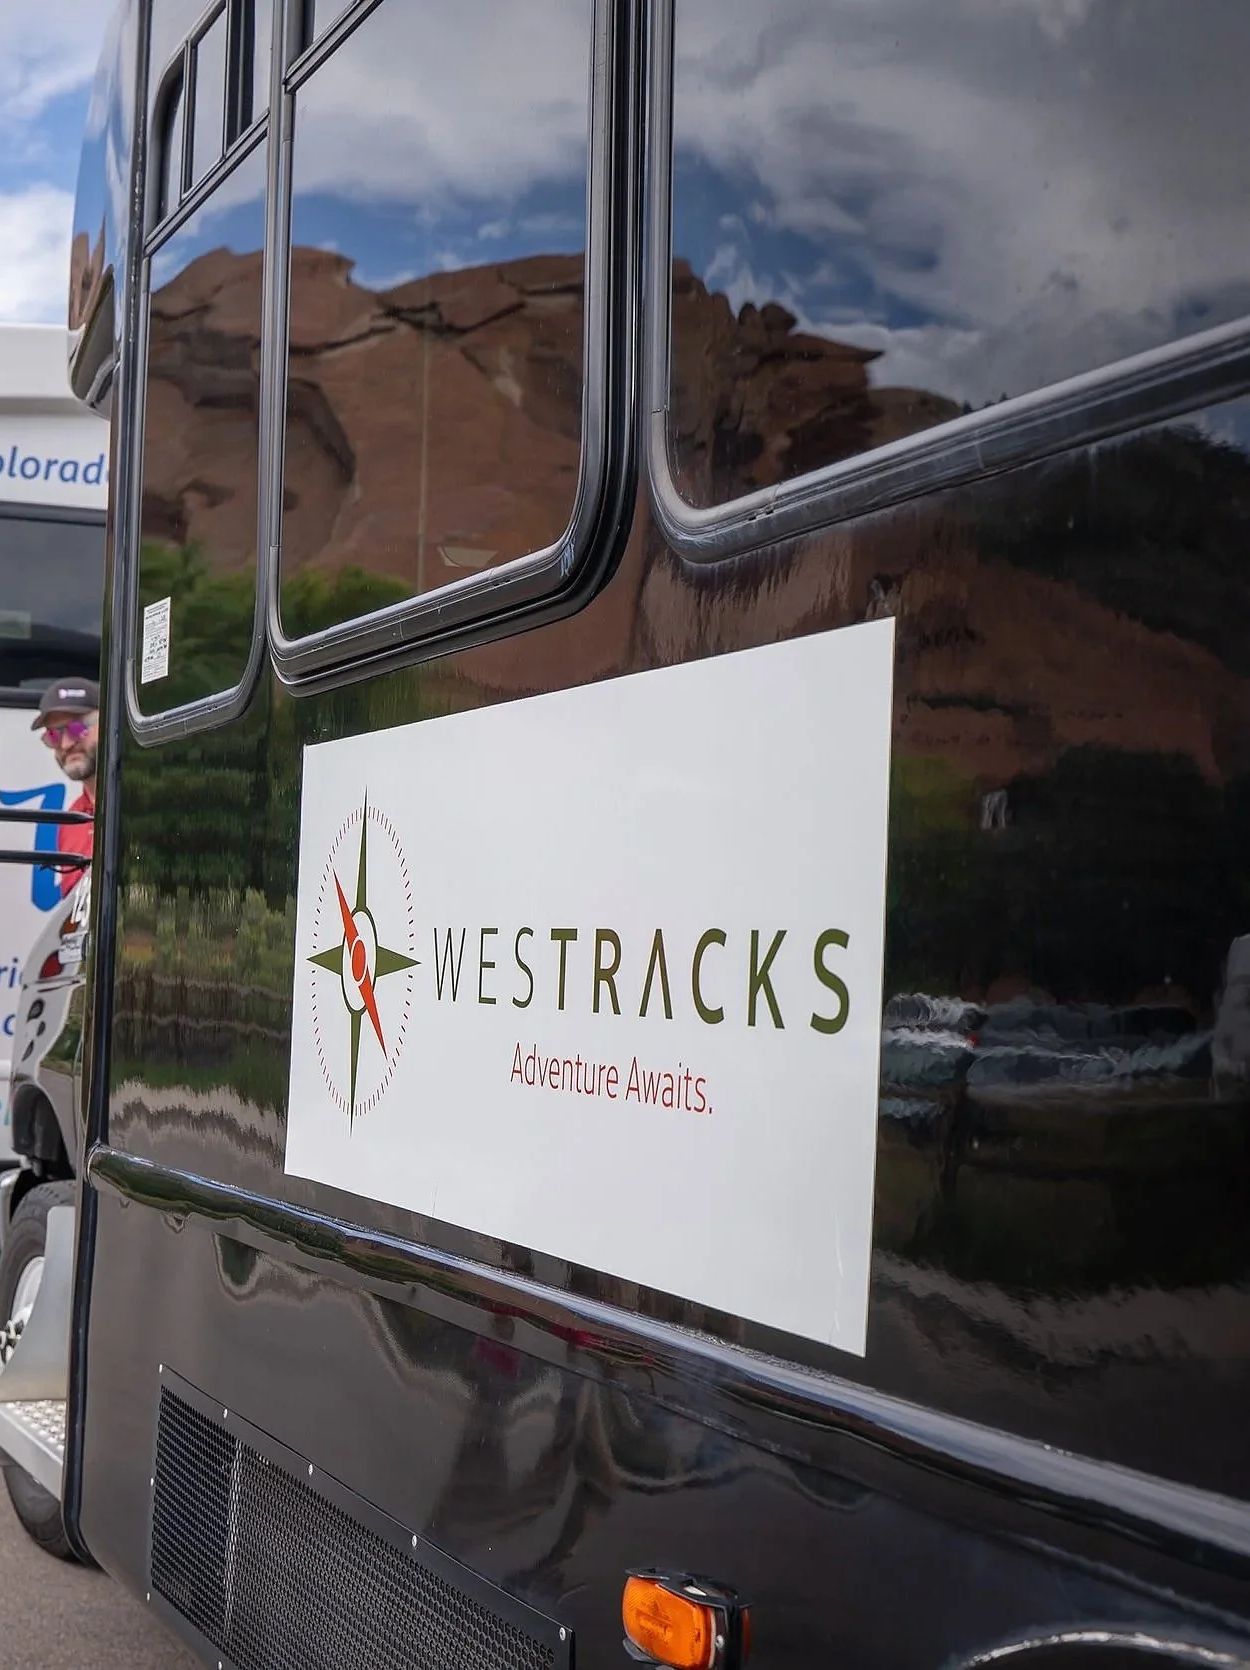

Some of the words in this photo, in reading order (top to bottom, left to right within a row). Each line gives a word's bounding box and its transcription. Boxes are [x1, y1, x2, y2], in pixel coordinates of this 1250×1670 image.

[433, 927, 851, 1035] WESTRACKS
[510, 1042, 619, 1099] Adventure
[625, 1056, 713, 1115] Awaits.
